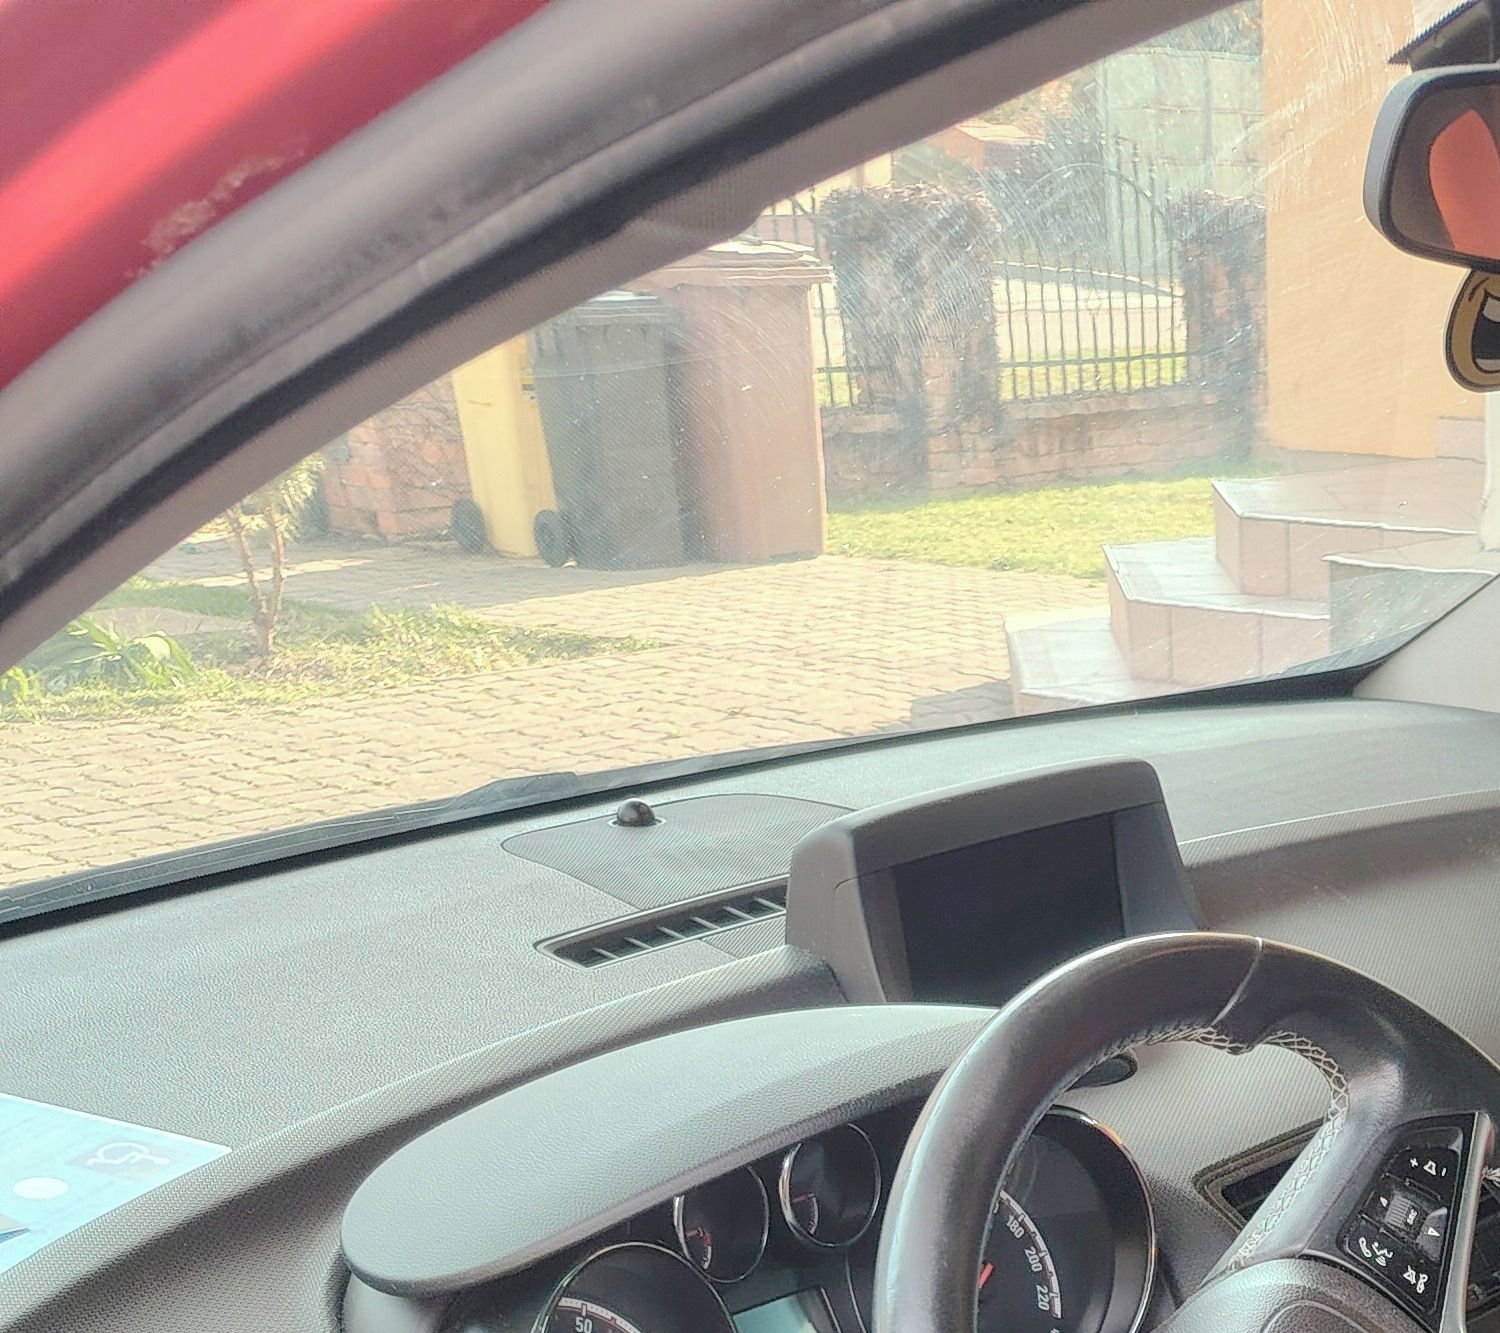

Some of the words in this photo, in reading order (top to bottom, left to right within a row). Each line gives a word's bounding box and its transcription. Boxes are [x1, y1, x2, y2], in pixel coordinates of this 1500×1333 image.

[1006, 1214, 1025, 1239] 180
[1024, 1246, 1043, 1273] 200
[1036, 1284, 1050, 1311] 220
